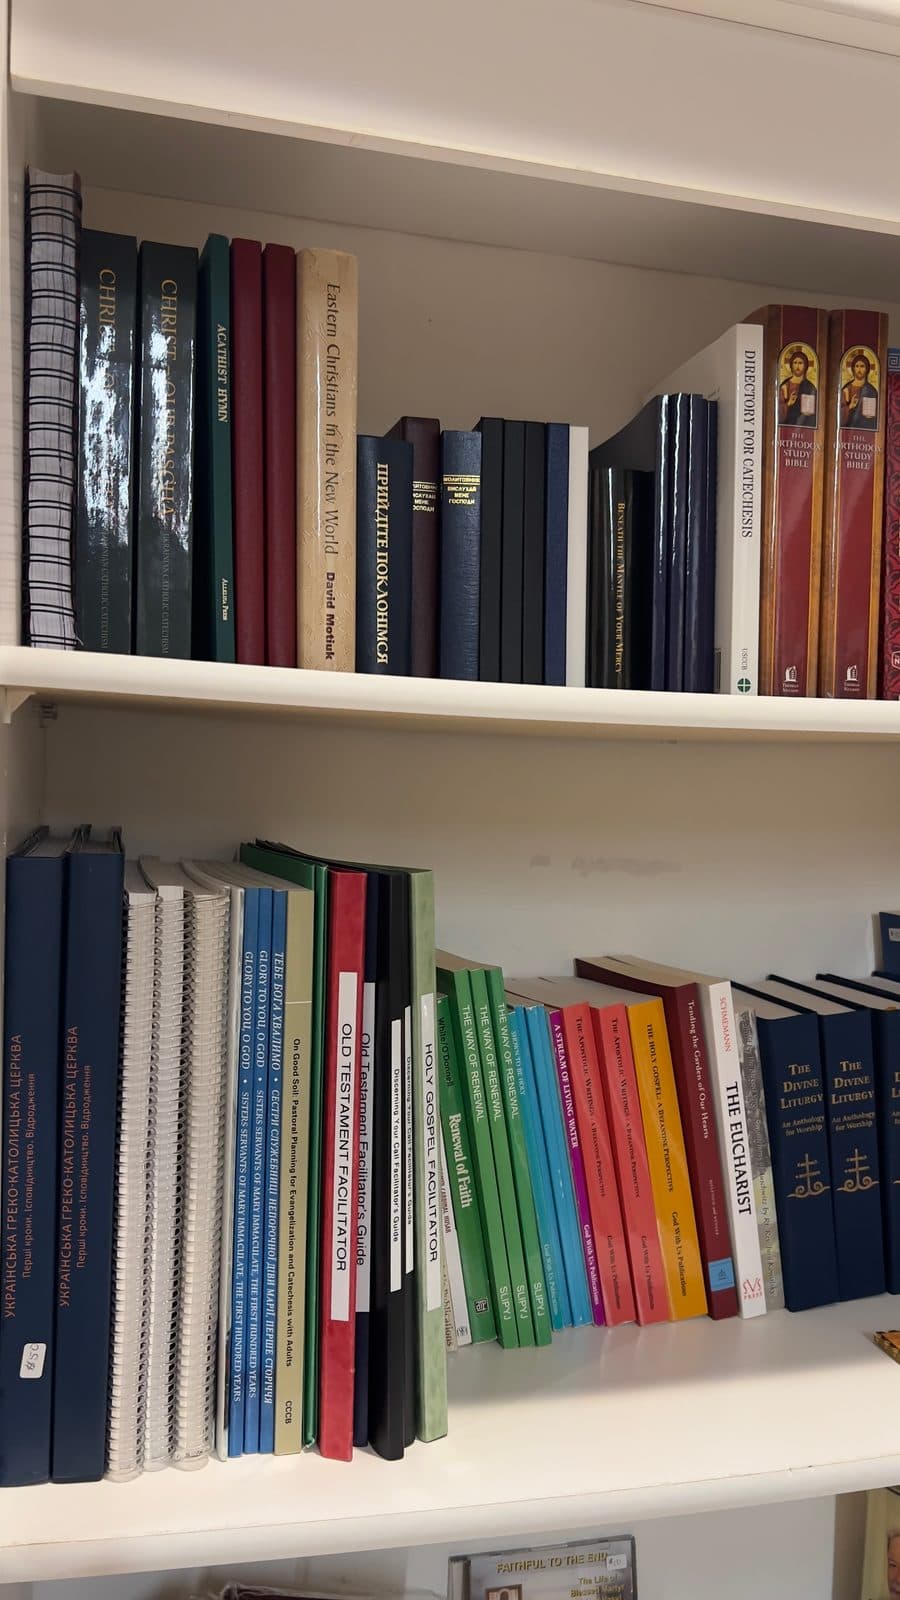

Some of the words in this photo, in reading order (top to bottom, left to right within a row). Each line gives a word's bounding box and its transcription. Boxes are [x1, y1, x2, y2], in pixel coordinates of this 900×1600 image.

[326, 283, 342, 338] Eastern
[217, 324, 228, 385] ACATHIST
[325, 343, 341, 417] Christians
[743, 350, 757, 427] DIRECTORY
[217, 387, 229, 424] HYMN
[325, 423, 340, 437] in
[742, 429, 756, 455] FOR
[325, 443, 340, 467] the
[783, 449, 811, 459] STUDY
[785, 459, 808, 469] BIBLE
[325, 471, 339, 504] New
[741, 457, 755, 538] CATECHESIS
[375, 463, 392, 548] ПРИЙДІТЕ
[324, 510, 339, 555] World
[616, 503, 626, 542] BENEATH
[616, 545, 625, 562] THE
[326, 571, 336, 609] David
[616, 563, 625, 599] MANTLE
[376, 551, 389, 664] ПОКЛОНІМСЯ
[615, 602, 624, 614] OF
[325, 613, 336, 660] Motiuk
[615, 615, 625, 641] YOUR
[614, 642, 624, 674] MERCY
[740, 648, 749, 671] USCCB
[245, 951, 254, 987] GLORY
[273, 952, 284, 980] ТЕБЕ
[244, 988, 253, 1004] TO
[272, 983, 284, 1011] БОГА
[242, 1006, 252, 1032] YOU,
[461, 1005, 472, 1027] THE
[479, 1005, 489, 1026] THE
[497, 1002, 506, 1024] THE
[687, 1000, 699, 1035] Tending
[719, 996, 732, 1053] SCHMEMANN
[243, 1033, 251, 1042] O
[271, 1014, 283, 1071] ХВАЛИМО
[292, 1038, 301, 1052] On
[341, 1023, 353, 1057] OLD
[360, 1032, 371, 1057] Old
[464, 1027, 476, 1051] WAY
[482, 1027, 494, 1051] WAY
[500, 1025, 511, 1048] WAY
[510, 1030, 520, 1056] SHOWN
[646, 1023, 654, 1040] THE
[692, 1035, 700, 1048] the
[9, 1033, 21, 1088] ЦЕРКВА
[65, 1026, 79, 1080] ЦЕРКВА
[242, 1044, 251, 1070] GOD
[292, 1053, 300, 1077] Good
[425, 1043, 434, 1086] HOLY
[468, 1053, 478, 1068] OF
[486, 1053, 495, 1068] OF
[503, 1050, 513, 1066] OF
[514, 1056, 522, 1067] TO
[555, 1032, 568, 1070] STREAM
[648, 1040, 659, 1064] HOLY
[693, 1050, 704, 1081] Garden
[839, 1060, 863, 1073] THE
[516, 1067, 523, 1077] BE
[561, 1071, 570, 1084] OF
[787, 1063, 812, 1076] THE
[834, 1075, 871, 1089] DIVINE
[291, 1078, 300, 1098] Soil:
[359, 1062, 370, 1137] Testament
[392, 1068, 401, 1116] Discerning
[471, 1070, 485, 1123] RENEWAL
[488, 1069, 502, 1122] RENEWAL
[506, 1067, 520, 1120] RENEWAL
[517, 1077, 527, 1096] HOLY
[563, 1084, 575, 1117] LIVING
[697, 1082, 705, 1092] of
[698, 1092, 707, 1110] Our
[726, 1081, 742, 1117] THE
[780, 1093, 824, 1110] LITURGY
[783, 1079, 820, 1093] DIVINE
[831, 1090, 875, 1105] LITURGY
[24, 1074, 36, 1139] Відродження
[240, 1091, 250, 1127] SISTERS
[270, 1089, 281, 1126] СЕСТРИ
[290, 1099, 300, 1135] Pastoral
[338, 1062, 352, 1161] TESTAMENT
[792, 1115, 825, 1127] Anthology
[393, 1118, 401, 1139] Your
[425, 1090, 437, 1156] GOSPEL
[448, 1112, 468, 1162] Renewal
[568, 1118, 580, 1149] WATER
[658, 1109, 669, 1148] BYZANTINE
[701, 1111, 710, 1139] Hearts
[785, 1128, 795, 1137] for
[796, 1124, 823, 1135] Worship
[6, 1091, 21, 1231] ГРЕКО-КАТОЛИЦЬКА
[62, 1083, 78, 1222] ГРЕКО-КАТОЛИЦЬКА
[239, 1128, 249, 1173] SERVANTS
[267, 1128, 280, 1195] СЛУЖЕБНИЦІ
[288, 1136, 299, 1174] Planning
[393, 1141, 401, 1159] Call
[24, 1140, 35, 1212] Ісповідництво.
[239, 1175, 247, 1187] OF
[289, 1175, 298, 1188] for
[356, 1140, 369, 1220] Facilitator's
[454, 1162, 470, 1176] of
[663, 1148, 675, 1193] PERSPECTIVE
[729, 1121, 752, 1215] EUCHARIST
[238, 1188, 247, 1216] MARY
[392, 1162, 401, 1214] Facilitator's
[457, 1175, 473, 1209] Faith
[287, 1189, 298, 1252] Evangelization
[336, 1164, 349, 1272] FACILITATOR
[428, 1159, 439, 1263] FACILITATOR
[671, 1211, 680, 1227] God
[23, 1214, 34, 1248] кроки.
[267, 1198, 279, 1262] НЕПОРОЧНОЇ
[392, 1215, 401, 1243] Guide
[673, 1227, 684, 1245] With
[235, 1216, 247, 1279] IMMACULATE,
[356, 1224, 368, 1266] Guide
[676, 1245, 684, 1255] Us
[4, 1235, 18, 1319] УКРАЇНСЬКА
[21, 1249, 33, 1280] Перші
[58, 1224, 73, 1308] УКРАЇНСЬКА
[266, 1262, 277, 1286] ДІВИ
[287, 1253, 296, 1270] and
[678, 1256, 689, 1297] Publications
[235, 1281, 244, 1298] THE
[286, 1271, 296, 1317] Catechesis
[499, 1285, 512, 1321] SLIPYJ
[516, 1284, 529, 1320] SLIPYJ
[533, 1281, 545, 1317] SLIPYJ
[234, 1301, 244, 1325] FIRST
[286, 1318, 295, 1339] with
[233, 1326, 244, 1372] HUNDRED
[265, 1320, 275, 1356] ПЕРШЕ
[285, 1339, 295, 1368] Adults
[233, 1373, 242, 1402] YEARS
[263, 1357, 274, 1405] СТОРІЧЧЯ
[284, 1400, 293, 1425] CCCB
[495, 1559, 547, 1574] FAITHFUL
[549, 1557, 563, 1568] TO
[565, 1555, 585, 1567] THE
[587, 1551, 609, 1564] END
